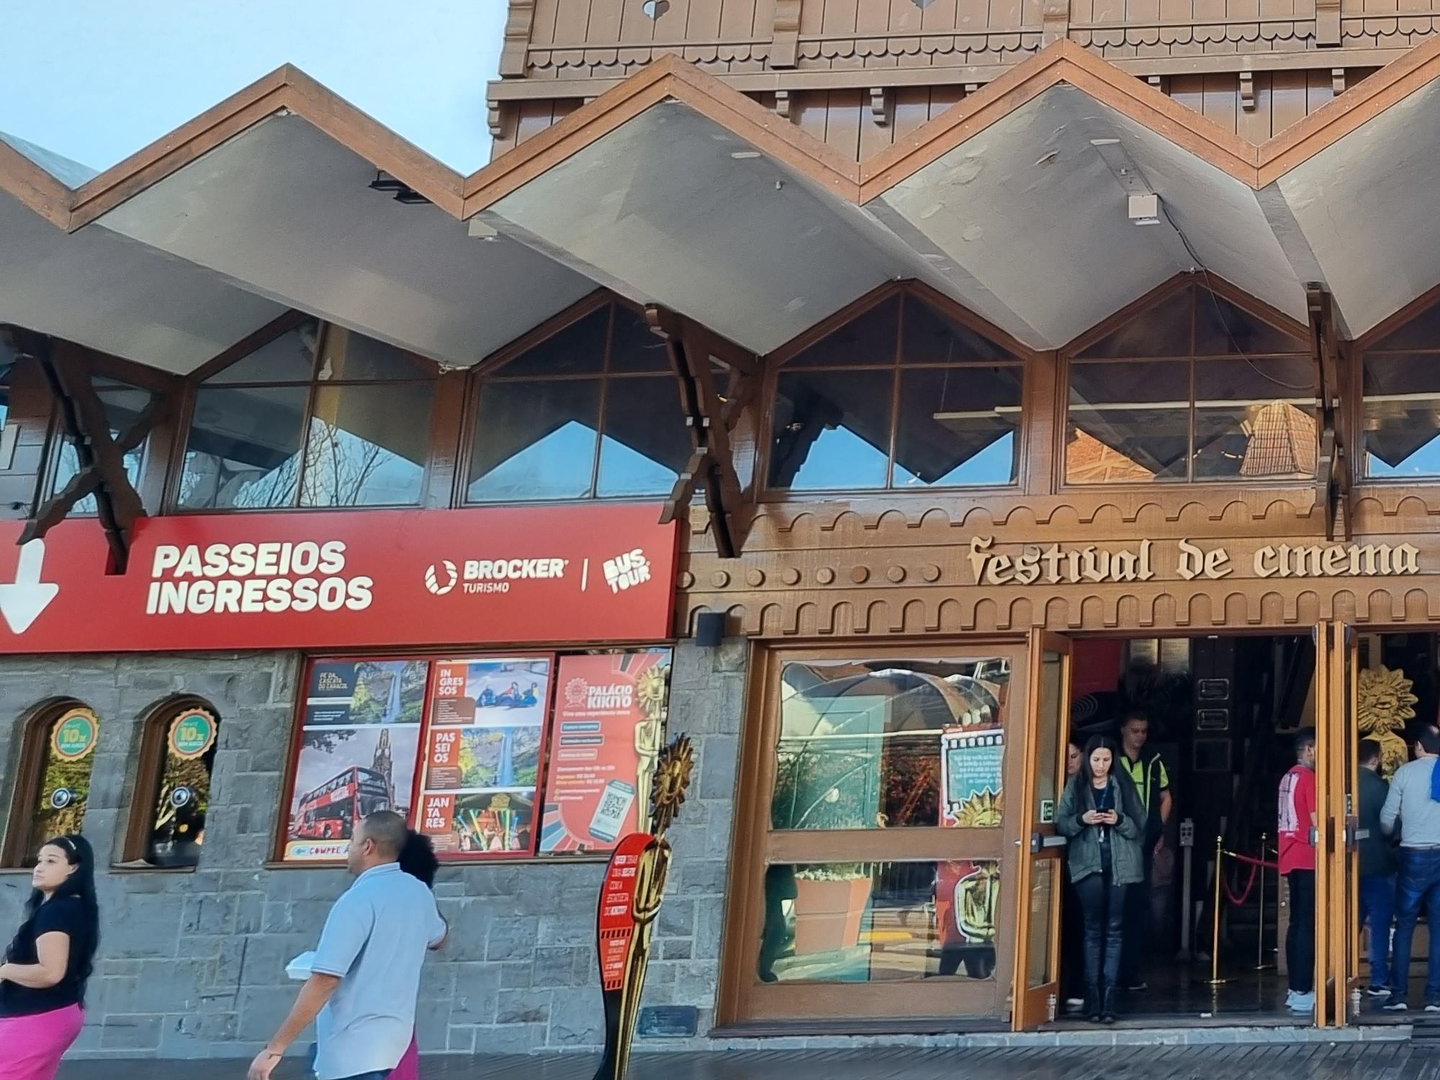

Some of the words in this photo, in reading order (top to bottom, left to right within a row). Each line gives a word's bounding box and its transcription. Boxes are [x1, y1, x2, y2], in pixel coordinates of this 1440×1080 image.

[152, 540, 346, 578] PASSEIOS
[1177, 538, 1232, 580] de
[1253, 541, 1420, 579] cinema
[463, 558, 566, 580] BROCKER
[606, 564, 651, 594] TOUR
[462, 582, 510, 594] TURISMO
[146, 576, 374, 615] INGRESSOS
[440, 669, 451, 677] IN
[440, 677, 464, 687] GRES
[439, 686, 457, 695] SOS
[587, 683, 633, 696] PALÁCIO
[587, 696, 632, 709] KIKITO
[436, 732, 455, 742] PAS
[435, 743, 450, 753] SEI
[434, 753, 449, 763] OS
[427, 797, 449, 808] JAN
[427, 808, 440, 818] TA
[425, 818, 445, 828] RES
